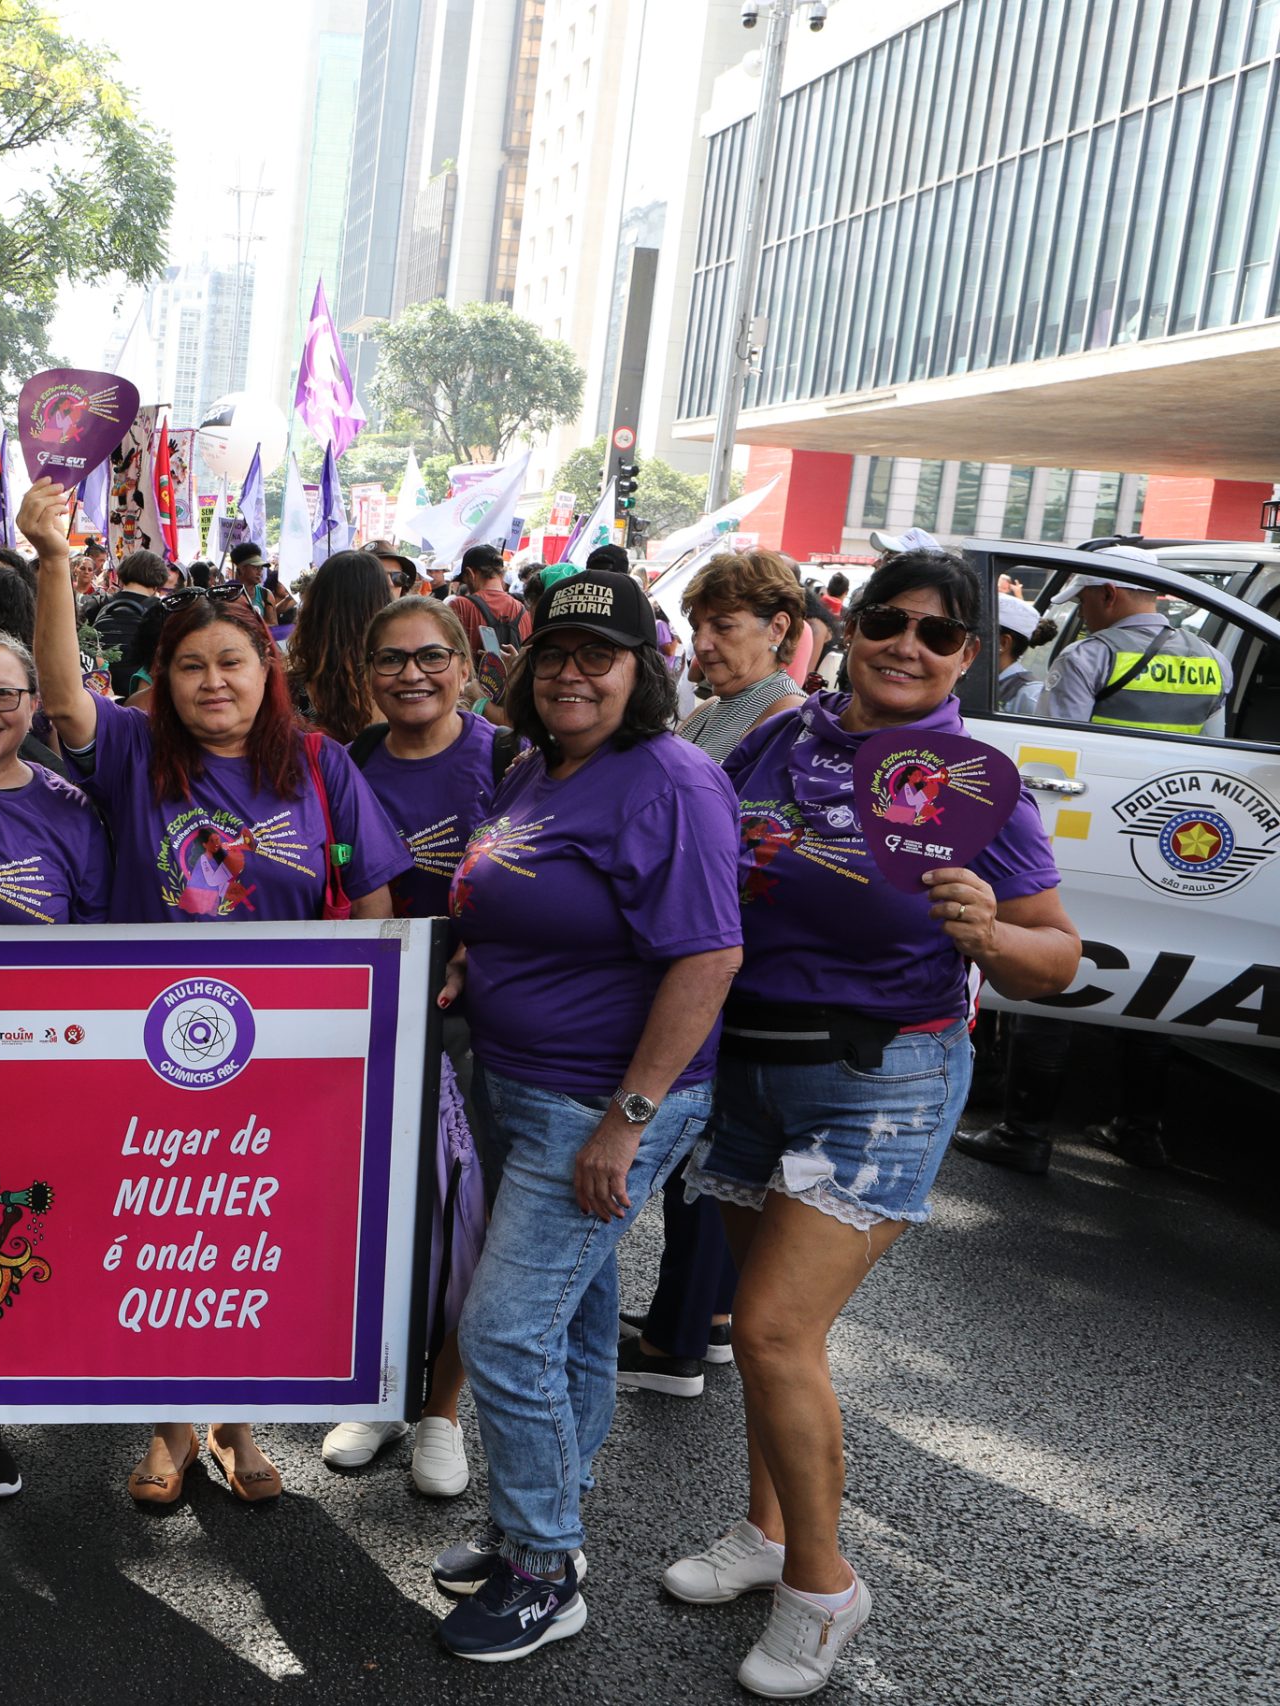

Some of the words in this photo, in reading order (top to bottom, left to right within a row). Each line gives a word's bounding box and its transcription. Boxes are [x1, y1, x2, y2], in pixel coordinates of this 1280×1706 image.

[66, 456, 87, 465] CUT
[553, 582, 614, 601] RESPEITA
[548, 600, 611, 619] HISTÓRIA
[1136, 662, 1217, 686] POLÍCIA
[871, 770, 883, 795] Ainda
[881, 749, 918, 768] Estamos
[920, 750, 945, 767] Aqui!
[885, 760, 907, 780] Mulheres
[915, 758, 927, 767] luta
[1124, 776, 1201, 818] POLÍCIA
[1211, 778, 1279, 833] MILITAR
[172, 820, 198, 850] Mulheres
[225, 826, 238, 836] por
[427, 838, 449, 849] jornada
[157, 835, 170, 872] Ainda
[925, 843, 953, 856] CUT
[836, 866, 869, 884] golpistas
[1160, 877, 1180, 890] SÃO
[1182, 882, 1216, 892] PAULO
[16, 893, 41, 906] climática
[163, 982, 239, 1008] MULHERES
[160, 1060, 216, 1083] QUÍMICAS
[216, 1059, 240, 1079] ABC
[121, 1116, 220, 1167] Lugar
[230, 1114, 271, 1155] de
[112, 1172, 280, 1217] MULHER
[102, 1234, 128, 1272] é
[136, 1230, 218, 1272] onde
[231, 1230, 282, 1272] ela
[118, 1287, 269, 1332] QUISER
[518, 1593, 559, 1629] FILA
